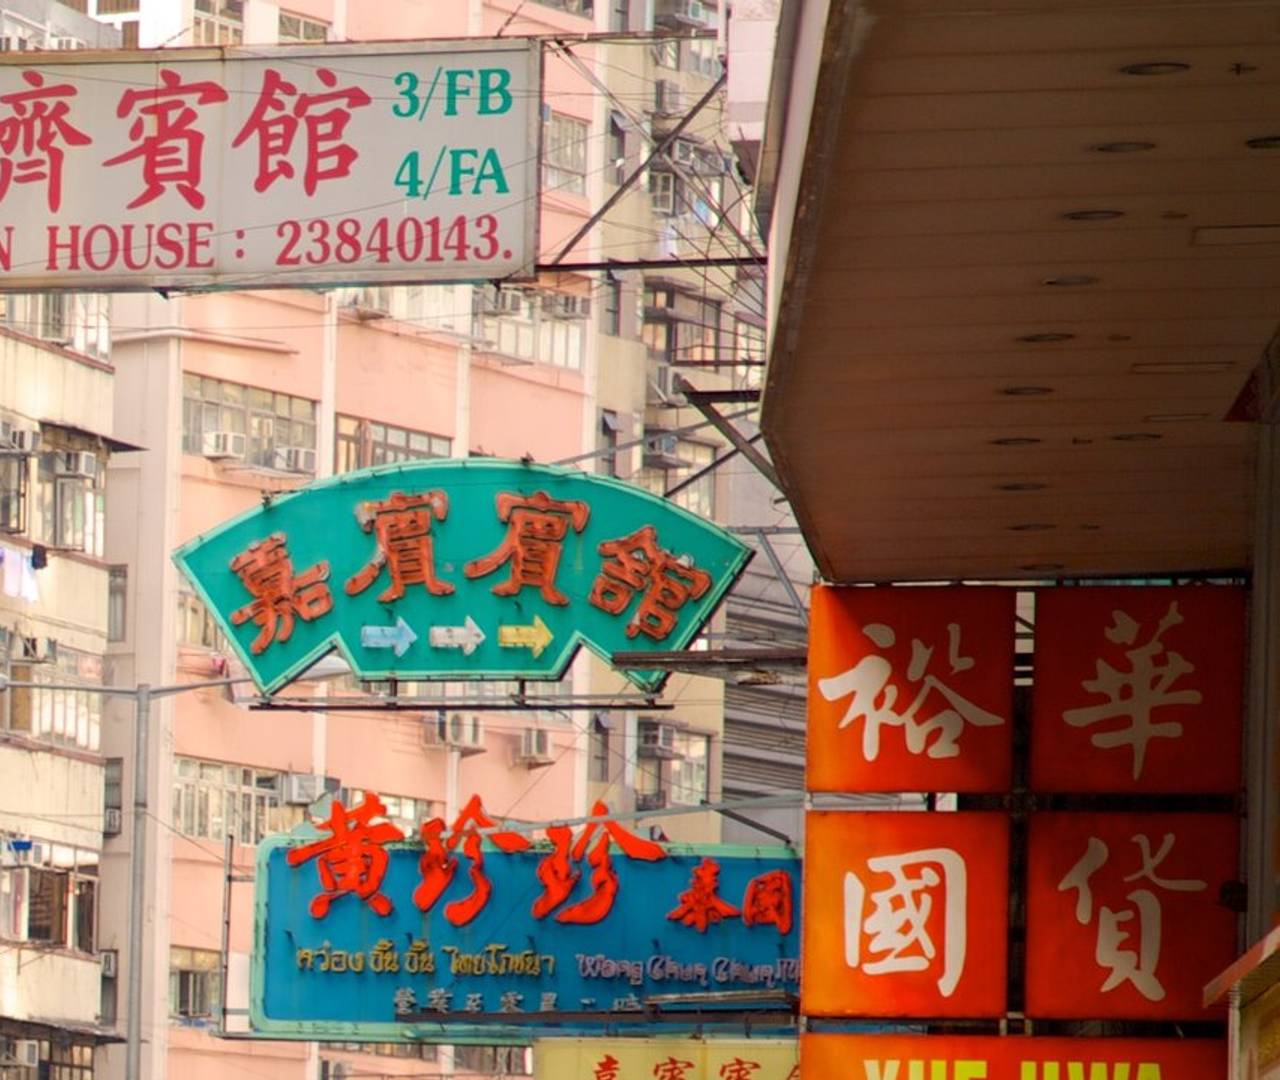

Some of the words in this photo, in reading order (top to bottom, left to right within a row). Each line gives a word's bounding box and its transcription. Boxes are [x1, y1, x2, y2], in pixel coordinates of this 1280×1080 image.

[392, 69, 513, 121] 3/FB
[394, 146, 510, 203] 4/FA
[231, 492, 711, 654] 嘉賓賓館
